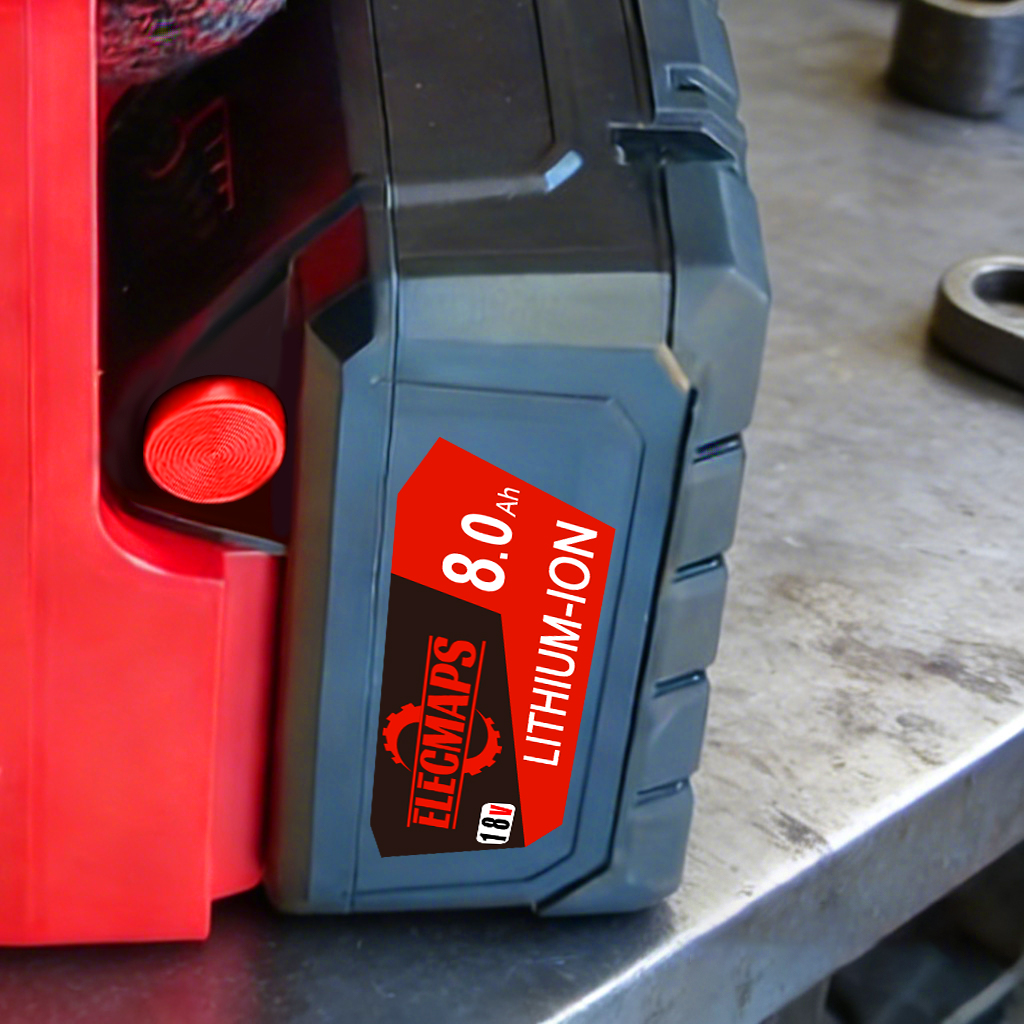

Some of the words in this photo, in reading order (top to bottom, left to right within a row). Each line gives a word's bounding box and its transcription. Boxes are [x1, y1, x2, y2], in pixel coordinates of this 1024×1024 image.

[412, 635, 478, 830] ELECMAPS
[523, 519, 598, 767] LITHIUM-ION
[479, 804, 515, 843] 18V
